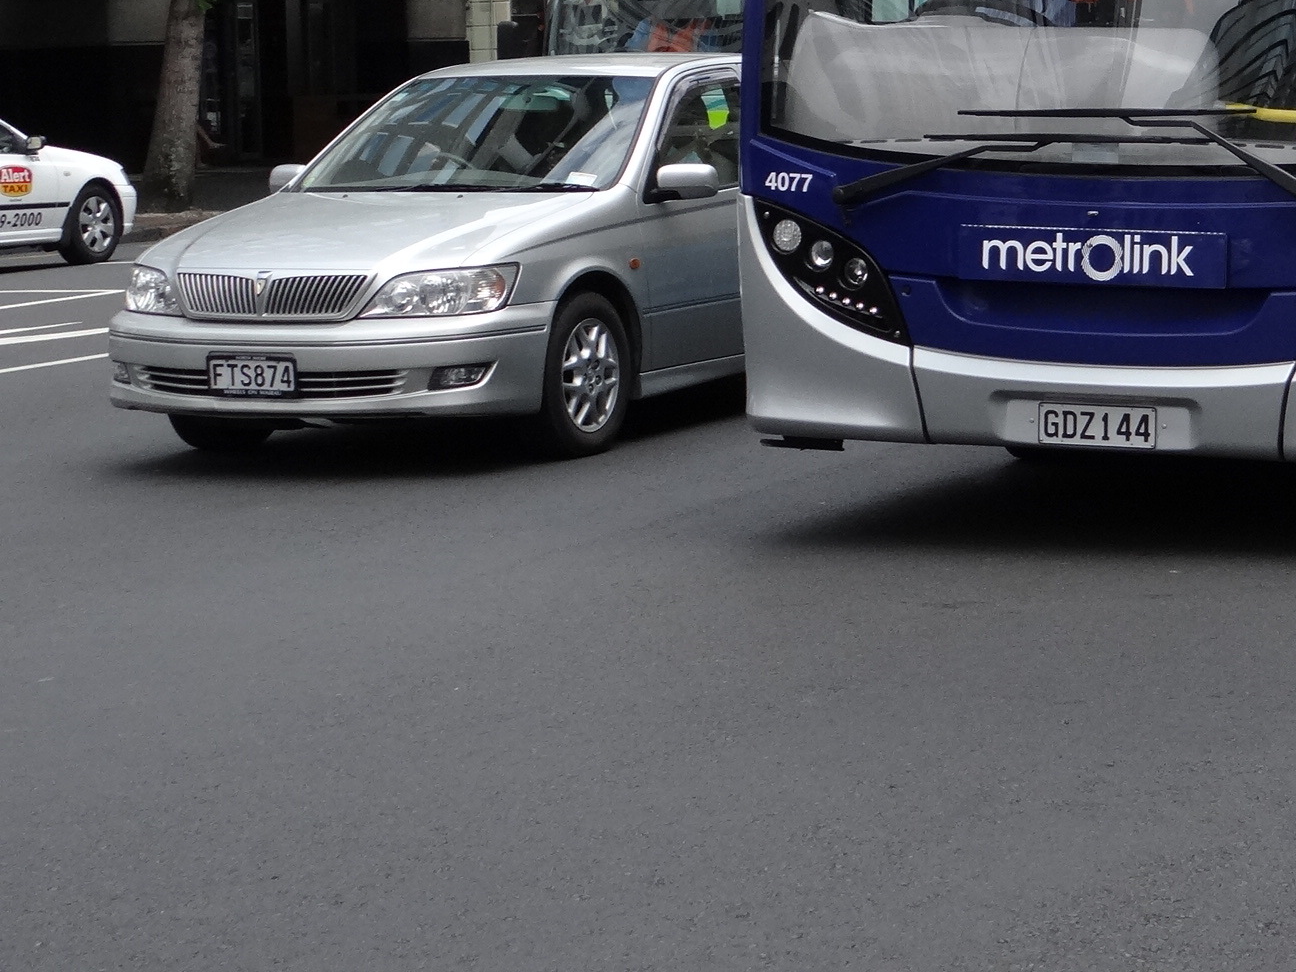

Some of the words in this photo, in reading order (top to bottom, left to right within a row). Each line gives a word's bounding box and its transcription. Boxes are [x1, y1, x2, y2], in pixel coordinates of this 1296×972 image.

[1, 168, 30, 183] Alert
[765, 171, 813, 192] 4077
[3, 184, 28, 193] TAXI
[212, 364, 292, 388] FTS874
[1044, 410, 1150, 442] GDZ144
